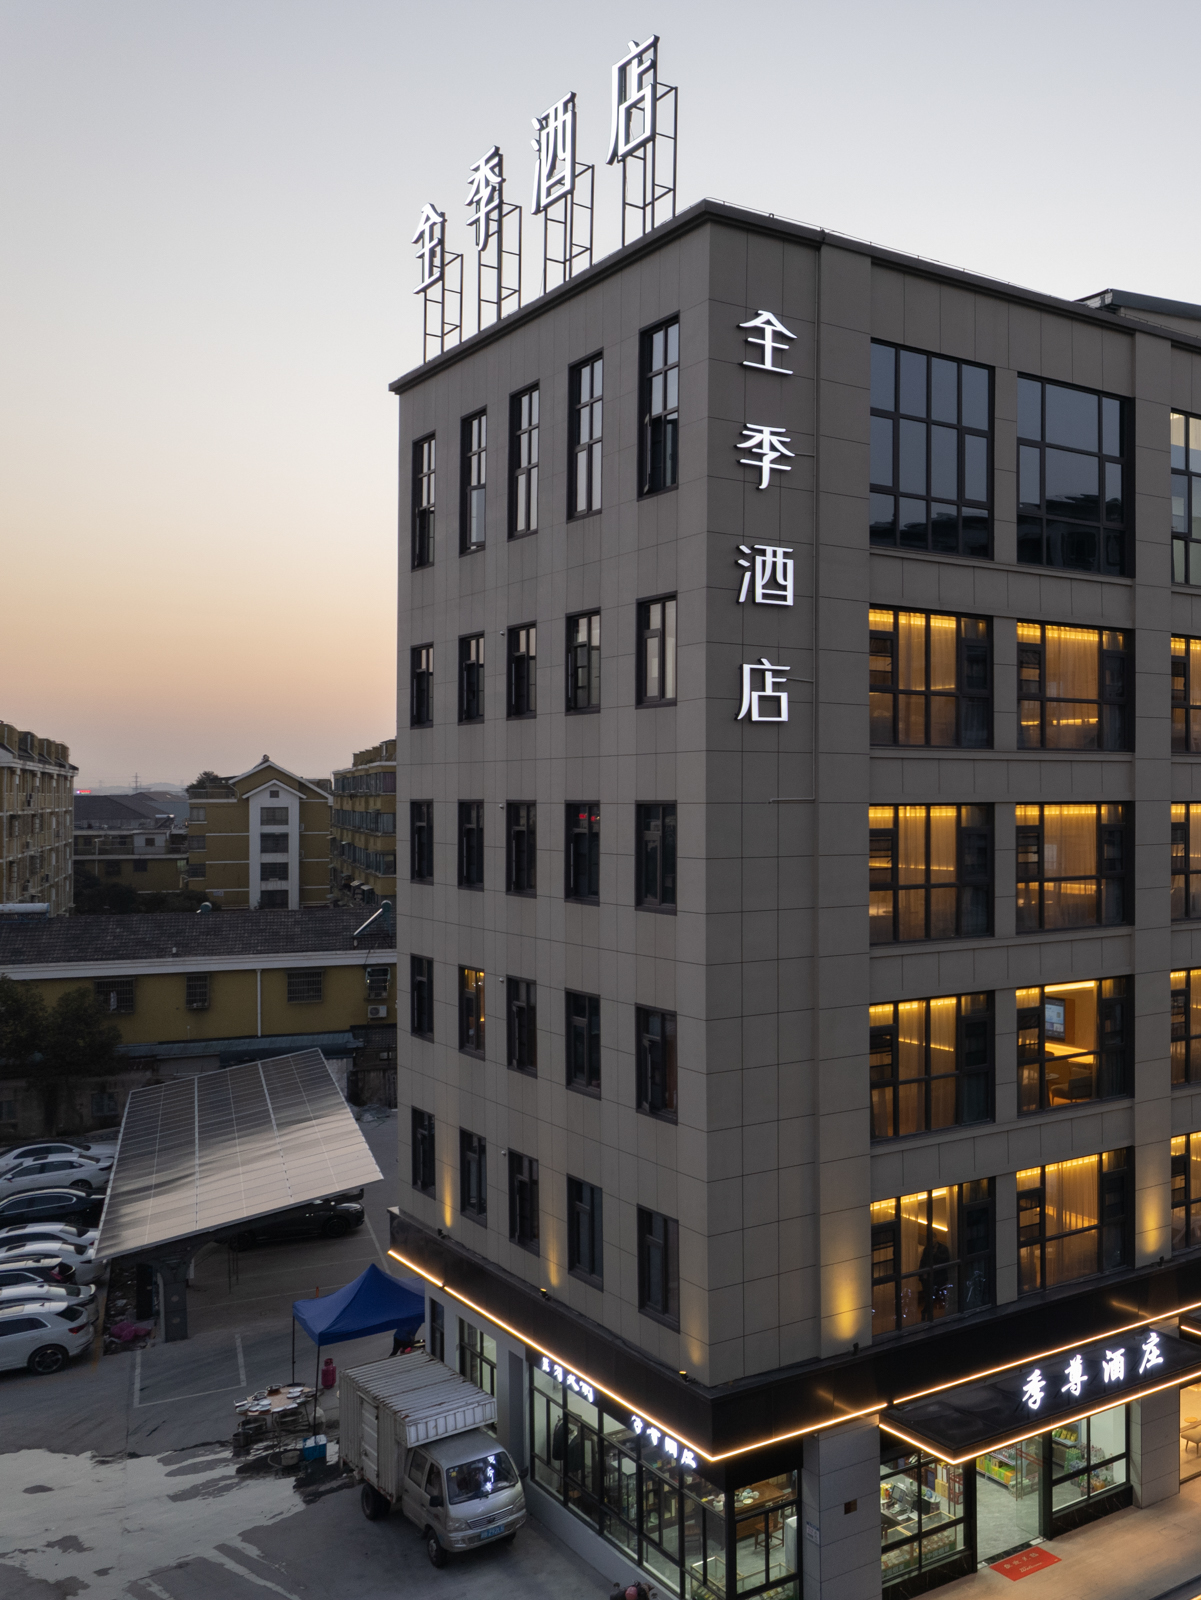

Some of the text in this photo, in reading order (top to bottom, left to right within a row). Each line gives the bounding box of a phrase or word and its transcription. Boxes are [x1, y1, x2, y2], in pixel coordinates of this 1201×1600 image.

[411, 34, 661, 296] 全季酒店
[735, 309, 798, 722] 全季酒店
[1021, 1331, 1164, 1410] 季尊酒庄
